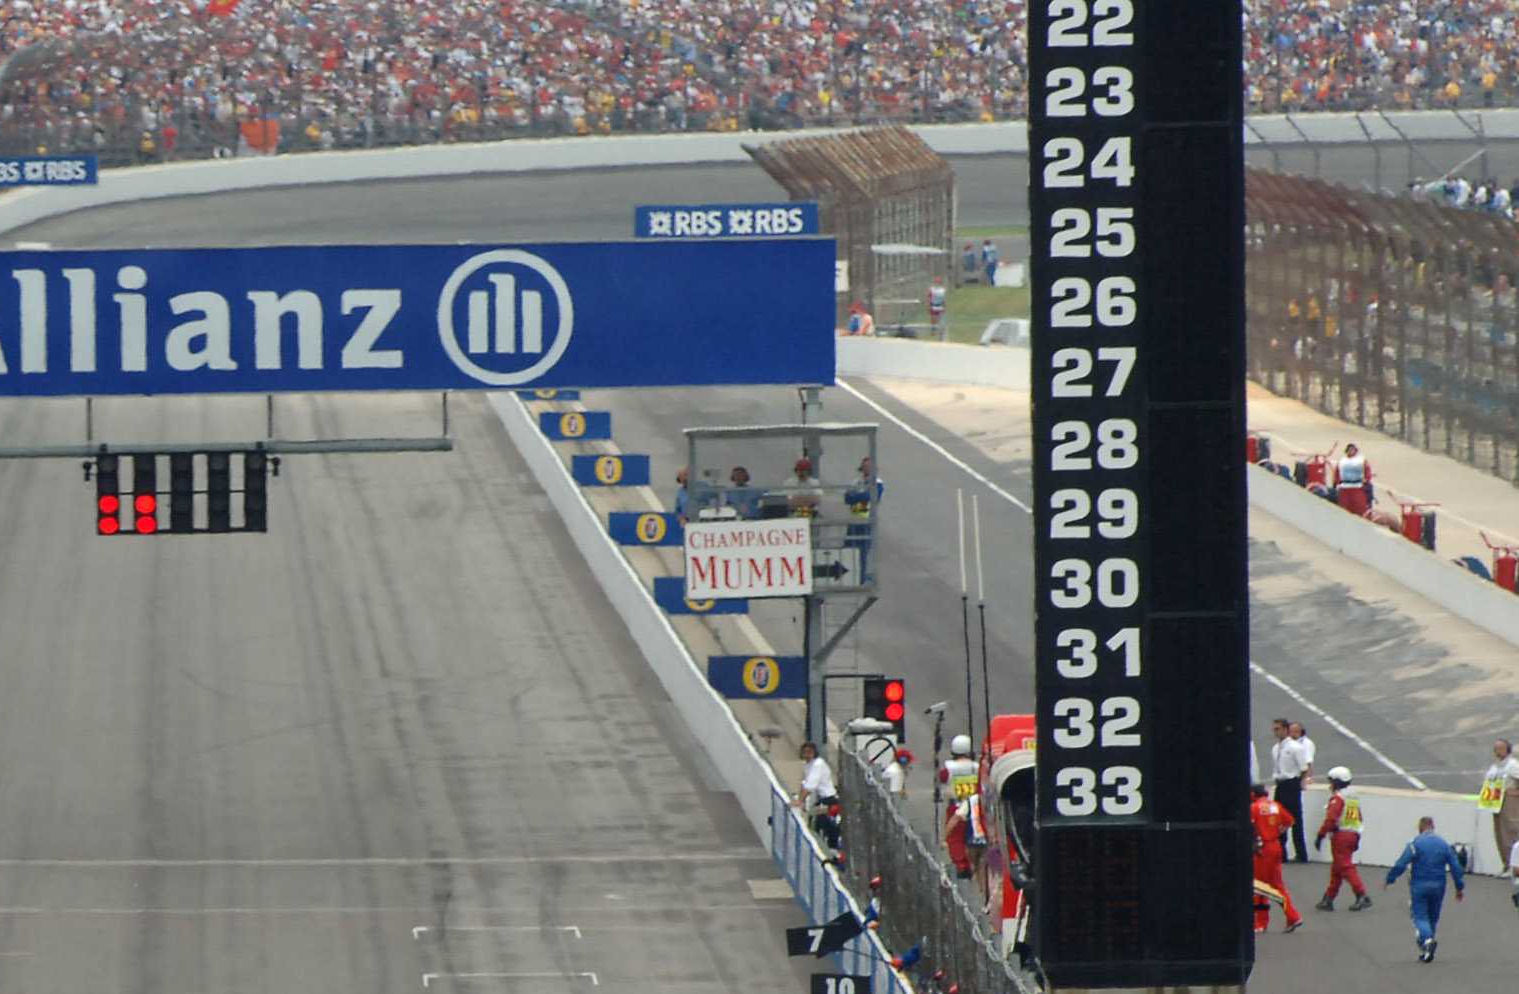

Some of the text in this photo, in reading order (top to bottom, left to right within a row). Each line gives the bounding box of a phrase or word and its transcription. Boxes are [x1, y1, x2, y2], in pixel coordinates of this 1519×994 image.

[1047, 0, 1134, 46] 22
[1046, 66, 1135, 117] 23
[46, 159, 86, 181] RBS
[1043, 136, 1135, 188] 24
[674, 207, 804, 236] RBS RBS
[1050, 207, 1136, 258] 25
[1050, 276, 1137, 328] 26
[1051, 346, 1137, 398] 27
[1051, 418, 1139, 471] 28
[688, 528, 806, 550] CHAMPAGNE
[1050, 488, 1138, 539] 29
[690, 555, 806, 591] MUMM
[1050, 558, 1139, 609] 30
[1056, 627, 1142, 679] 31
[1053, 696, 1141, 749] 32
[1055, 766, 1143, 816] 33
[808, 928, 825, 953] 7
